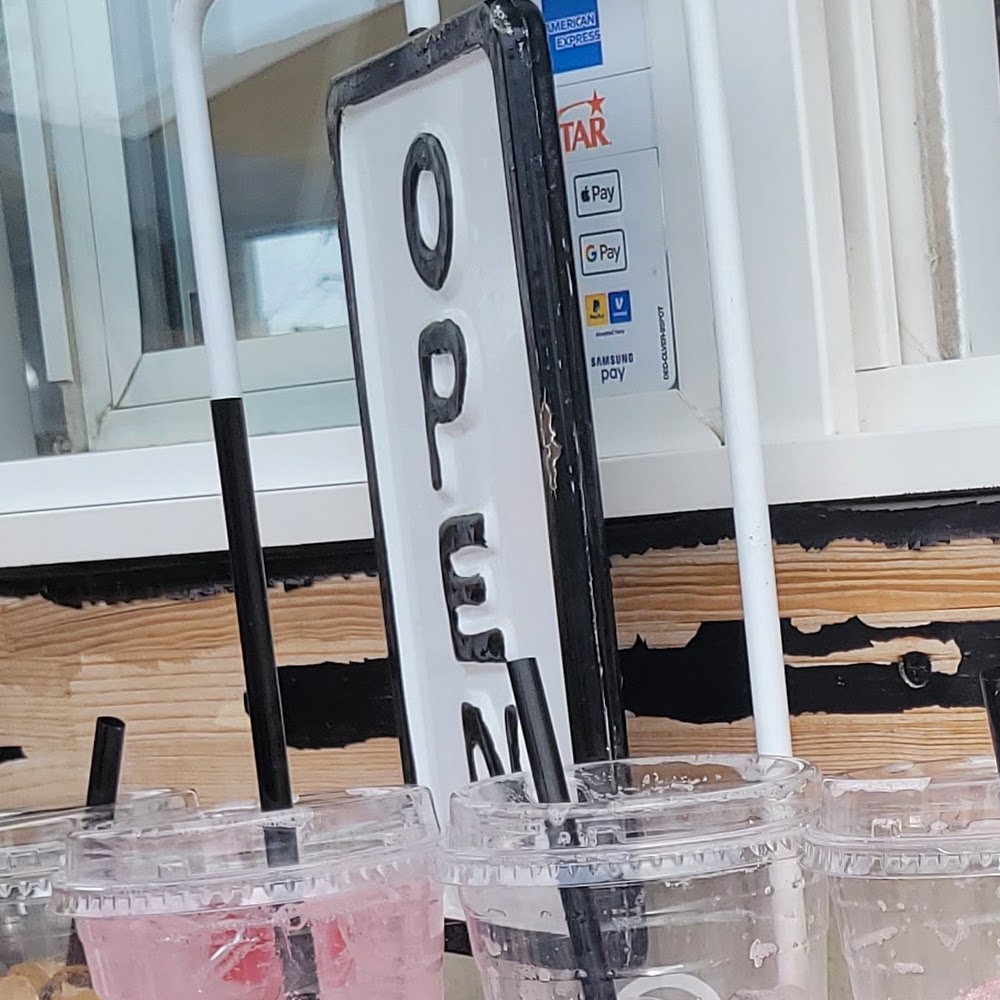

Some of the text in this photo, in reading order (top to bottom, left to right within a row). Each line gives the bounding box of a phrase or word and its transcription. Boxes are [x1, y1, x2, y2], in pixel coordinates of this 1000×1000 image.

[556, 30, 601, 49] EXPRESS
[558, 117, 610, 152] TAR
[591, 185, 615, 203] Pay
[599, 244, 621, 263] Pay
[591, 353, 634, 367] SAMSUNG
[601, 366, 626, 384] pay
